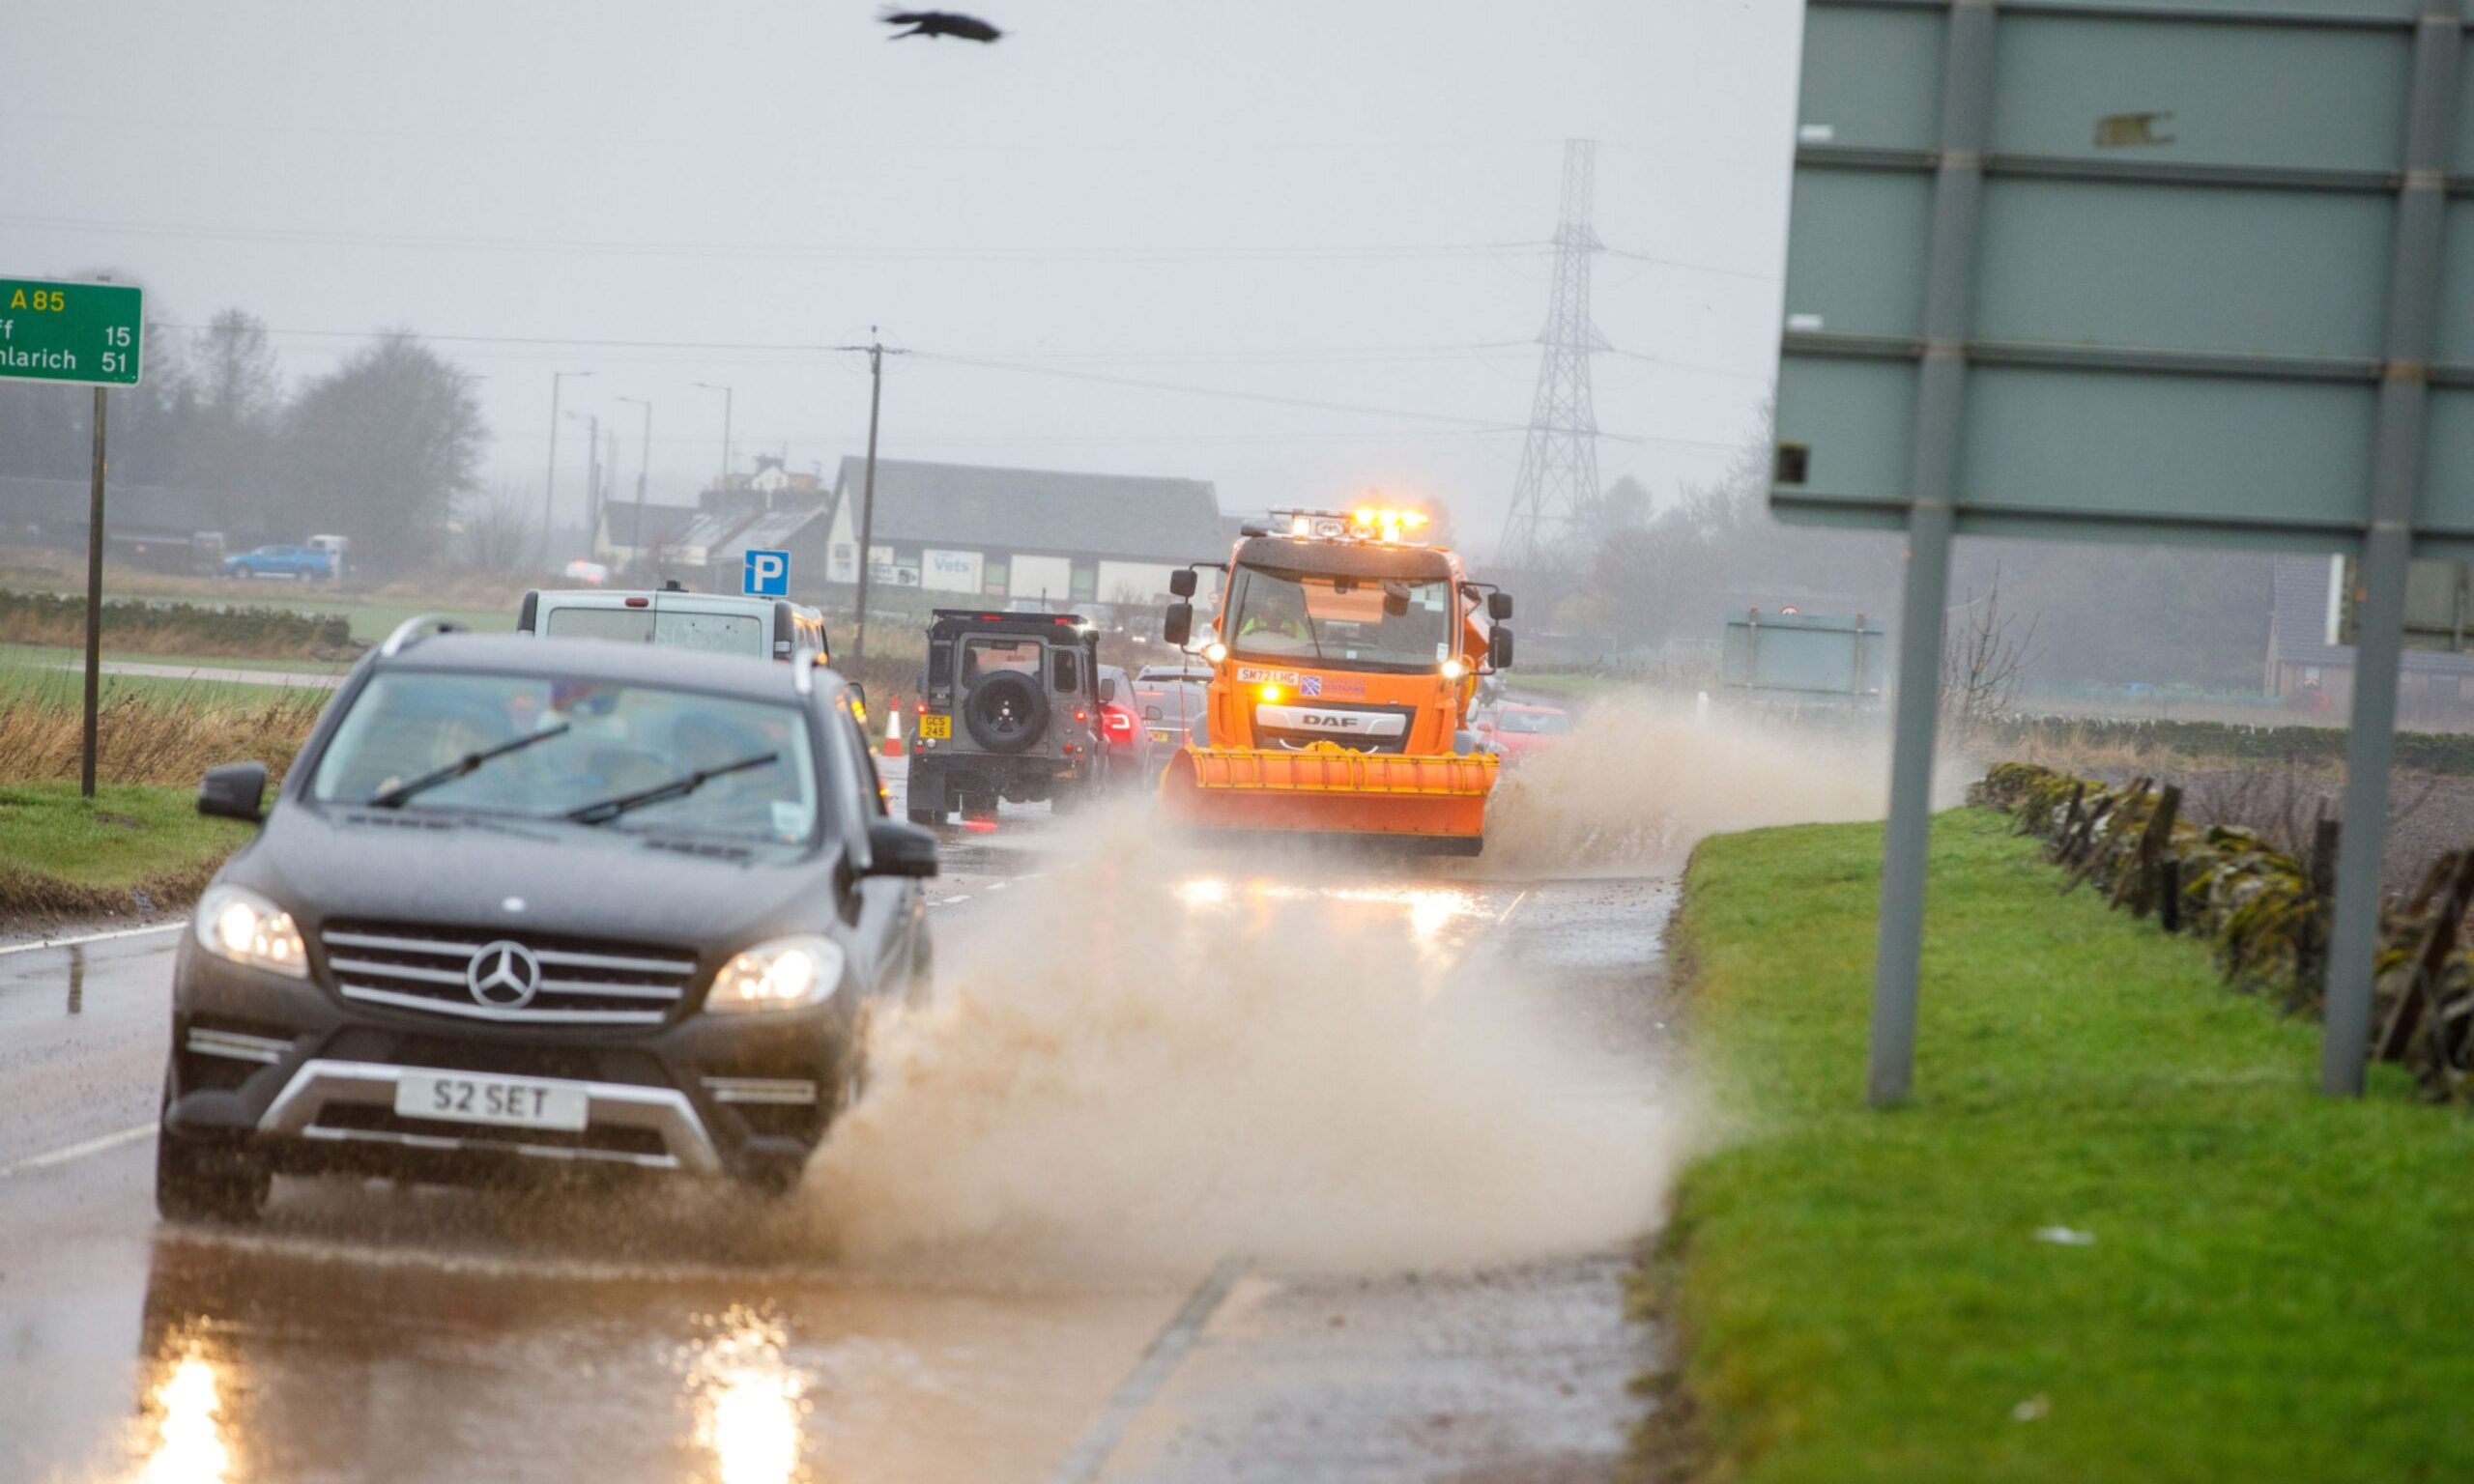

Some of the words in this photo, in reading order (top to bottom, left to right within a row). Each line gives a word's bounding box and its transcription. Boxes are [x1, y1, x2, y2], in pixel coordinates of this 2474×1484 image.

[105, 326, 131, 347] 15
[101, 352, 127, 373] 51
[754, 555, 783, 591] P
[934, 556, 969, 572] Vets
[926, 717, 945, 727] GCS
[1303, 715, 1358, 728] DAF
[926, 727, 945, 736] 245
[434, 1079, 475, 1112] S2
[485, 1083, 547, 1117] SET
